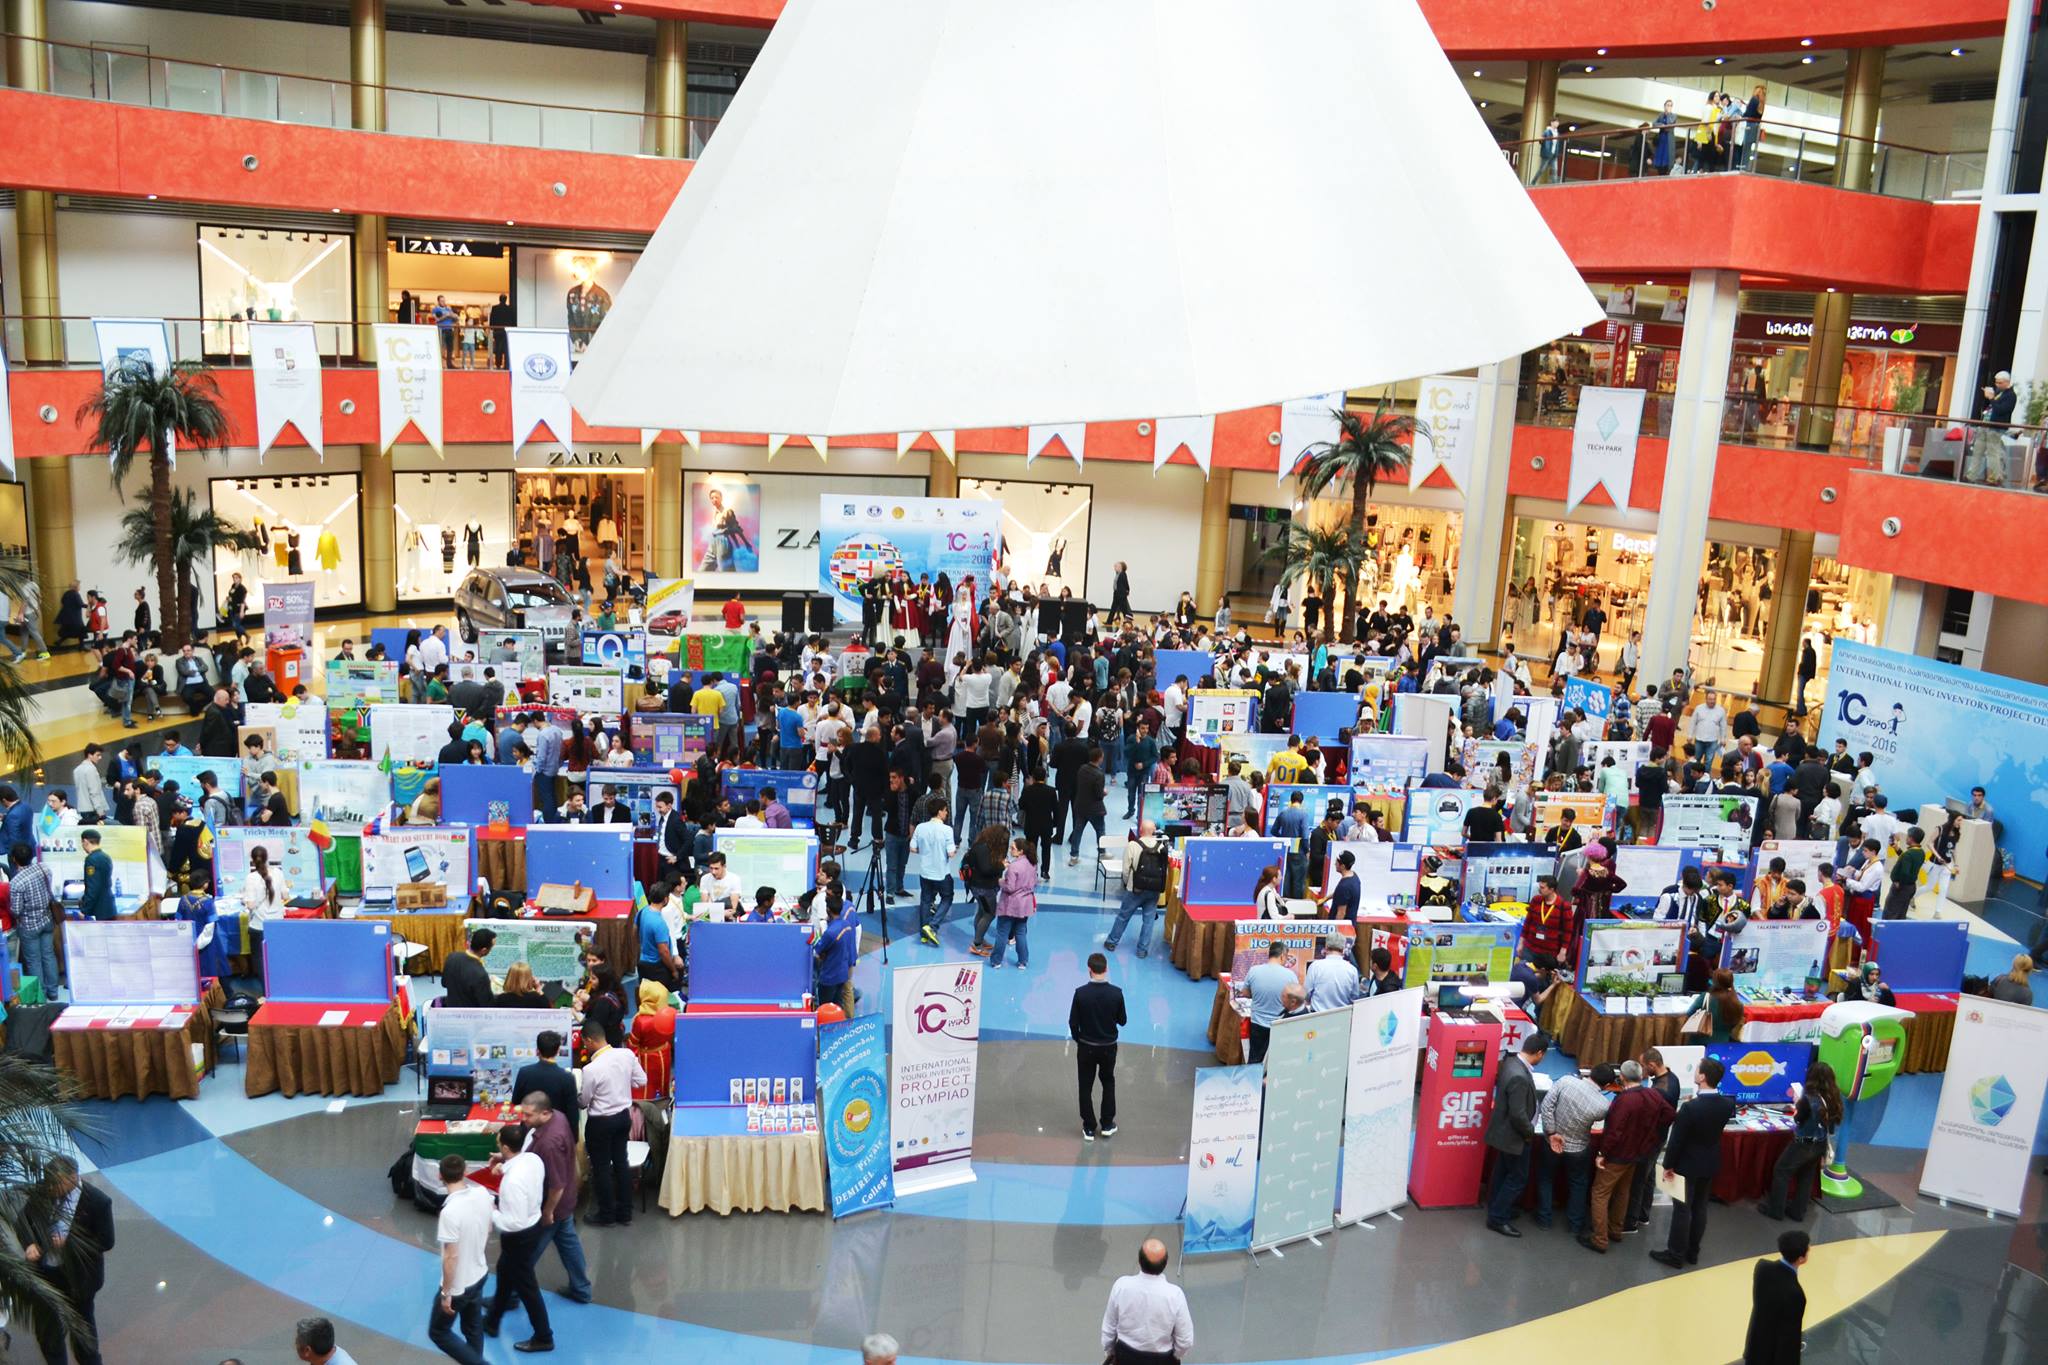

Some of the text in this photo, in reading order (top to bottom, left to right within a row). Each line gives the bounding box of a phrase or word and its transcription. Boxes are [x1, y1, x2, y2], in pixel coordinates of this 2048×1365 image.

[409, 241, 472, 256] ZARA
[1587, 443, 1622, 453] TECH PARK
[547, 451, 623, 466] ZARA
[1835, 664, 1903, 688] INTERNATIONAL
[1904, 682, 1936, 698] YOUNG
[1936, 691, 1990, 712] INVENTORS
[1990, 704, 2032, 723] PROJECT
[1838, 689, 1867, 726] 10
[1872, 736, 1897, 754] 2016
[1277, 765, 1297, 784] 01
[243, 828, 266, 837] Tricky
[1235, 923, 1280, 934] ELPFUL
[1282, 938, 1313, 949] AME
[954, 984, 974, 993] 2016
[914, 1003, 947, 1034] 10
[900, 1056, 972, 1074] INTERNATIONAL
[900, 1065, 971, 1082] YOUNG INVENTORS
[900, 1073, 970, 1095] PROJECT
[900, 1087, 970, 1109] OLYMPIAD
[1441, 1091, 1488, 1112] GIF
[1736, 1092, 1760, 1100] START
[1438, 1110, 1483, 1129] FER
[856, 1138, 885, 1172] Private
[833, 1170, 876, 1206] DEMIREL
[861, 1174, 890, 1205] College
